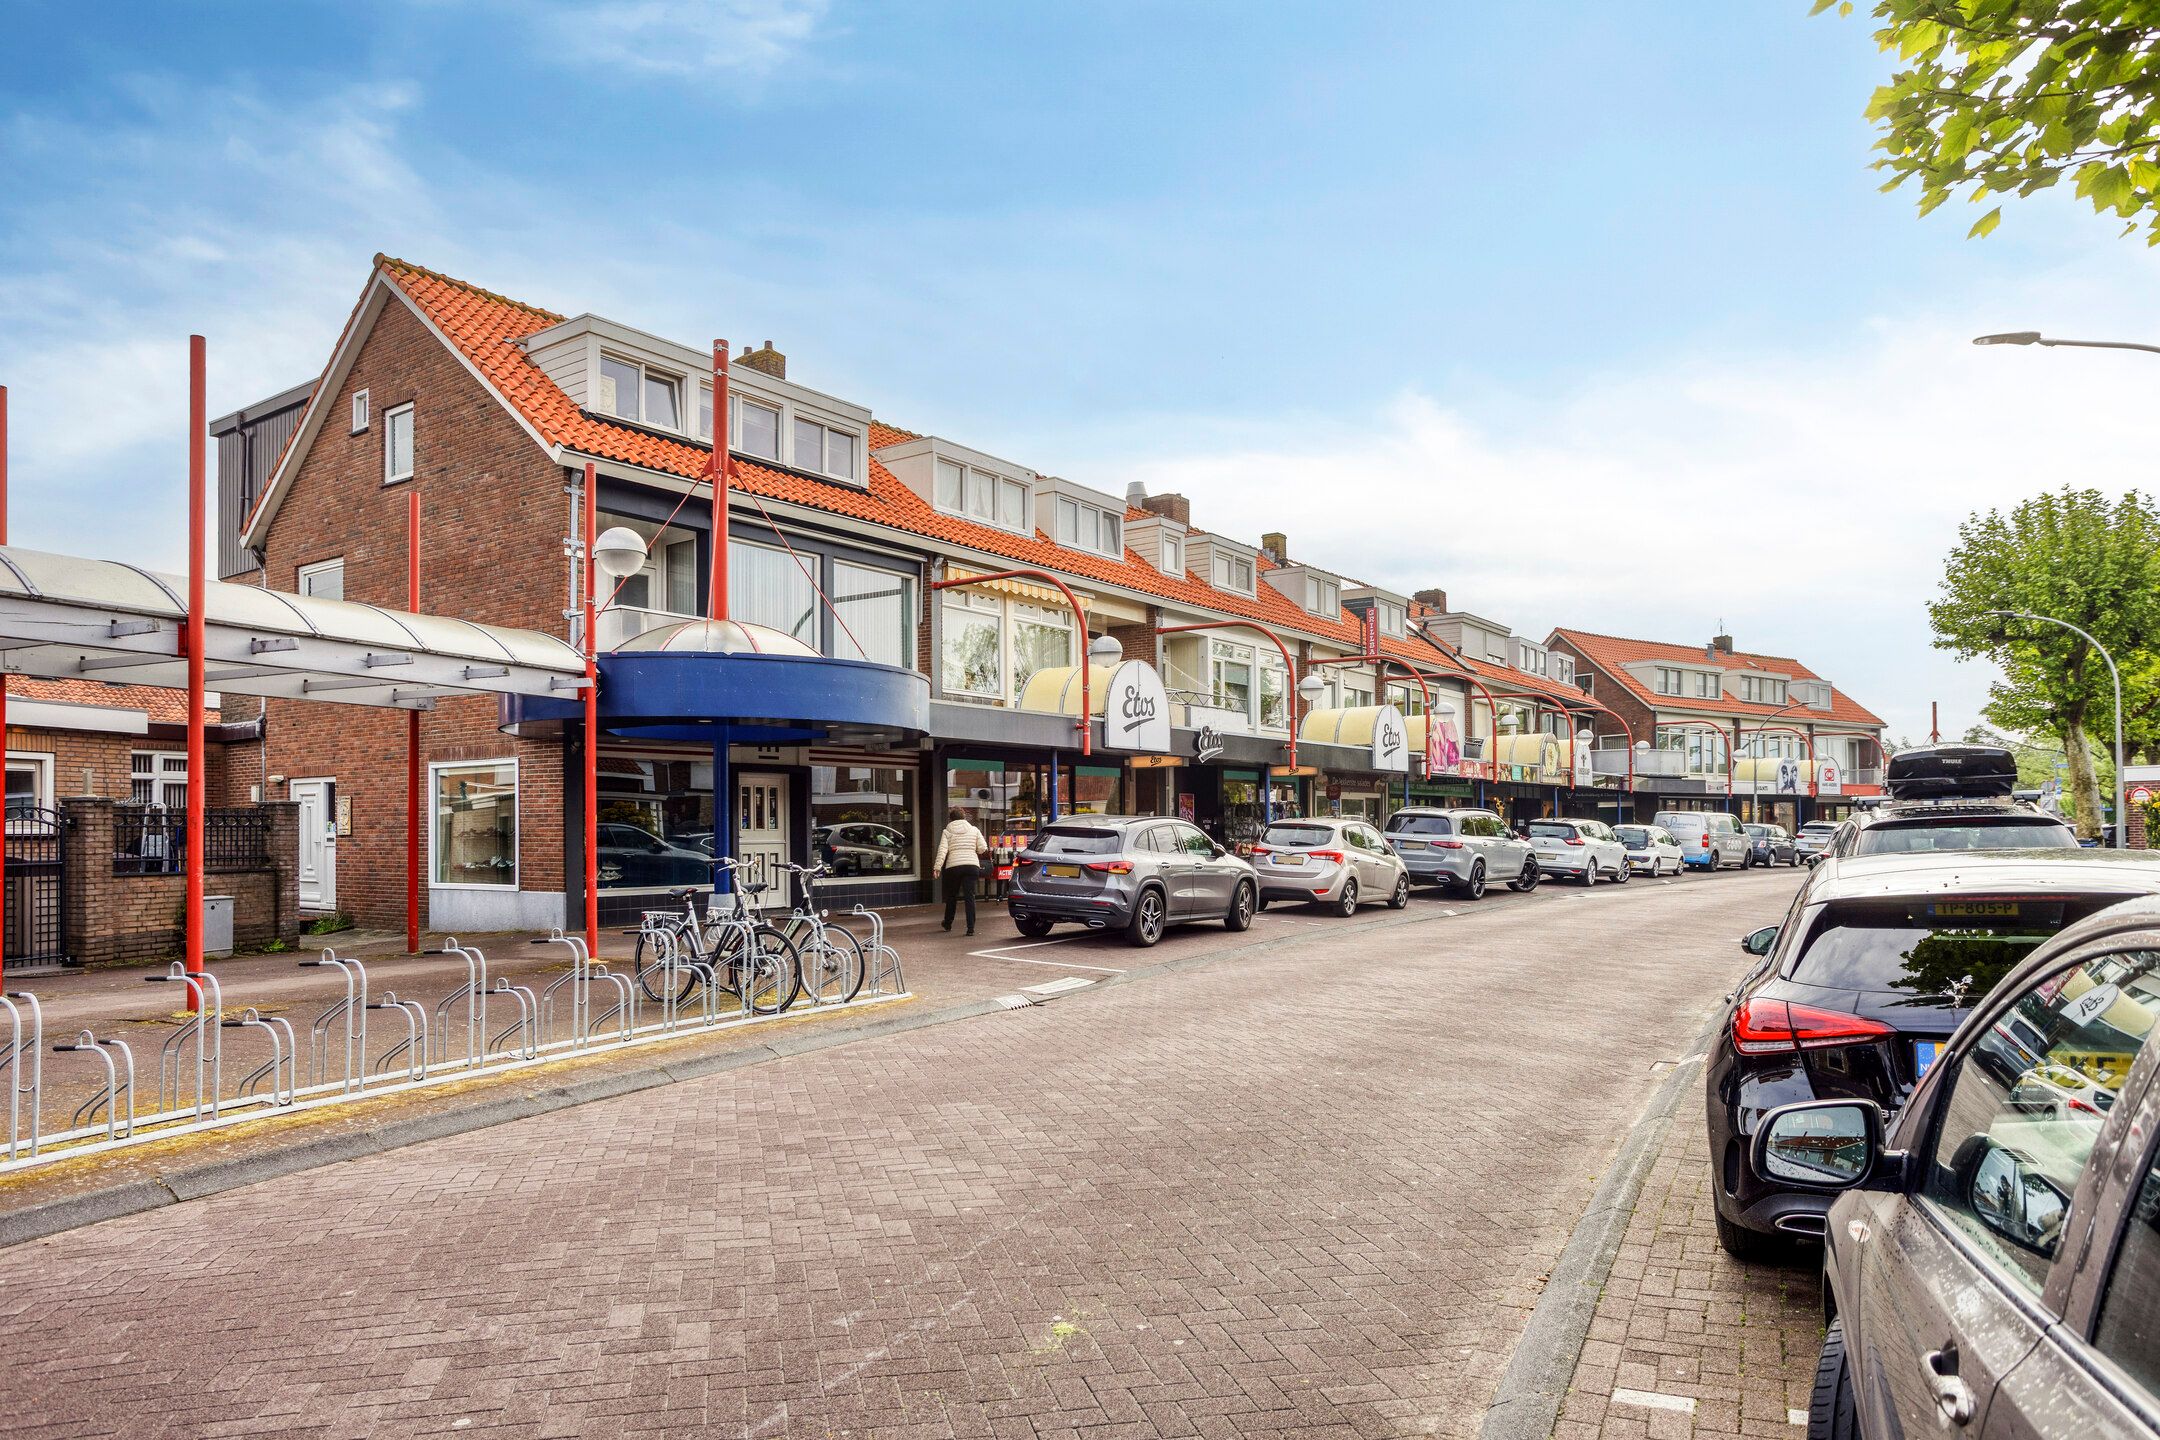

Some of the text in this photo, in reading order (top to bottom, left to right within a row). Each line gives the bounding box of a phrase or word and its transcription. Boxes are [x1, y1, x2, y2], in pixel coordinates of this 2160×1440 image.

[1368, 609, 1376, 662] GRILLBA
[1122, 685, 1155, 719] Etos
[1199, 725, 1224, 751] Etos
[1382, 723, 1400, 748] Etos
[1150, 756, 1162, 764] Etos
[1920, 1063, 1930, 1071] N
